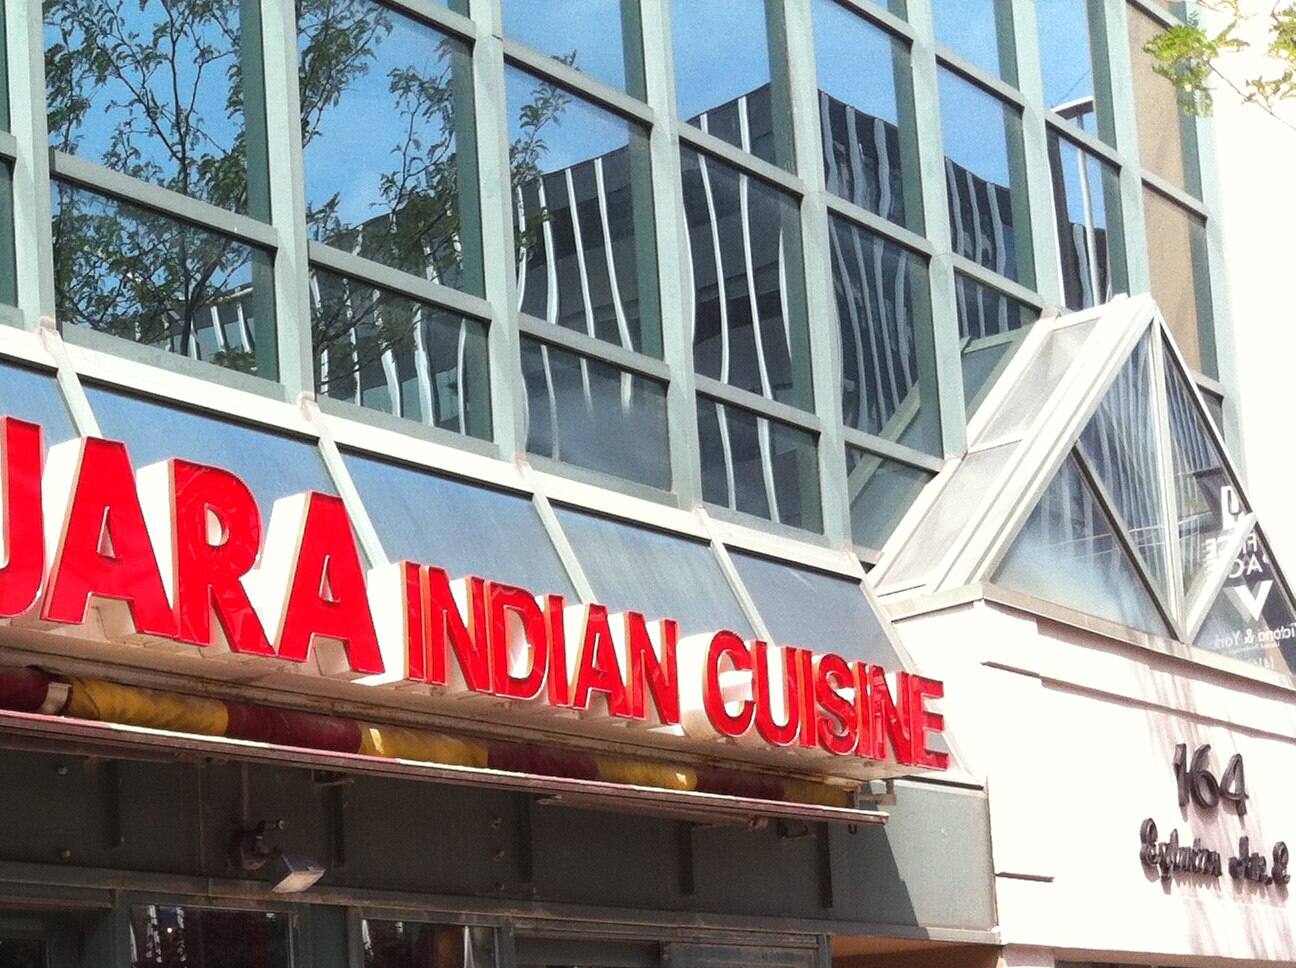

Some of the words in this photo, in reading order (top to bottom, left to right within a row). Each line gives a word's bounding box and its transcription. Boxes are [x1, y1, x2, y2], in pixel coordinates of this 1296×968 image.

[402, 559, 680, 727] INDIAN
[703, 629, 951, 771] CUISINE
[1173, 743, 1250, 817] 164
